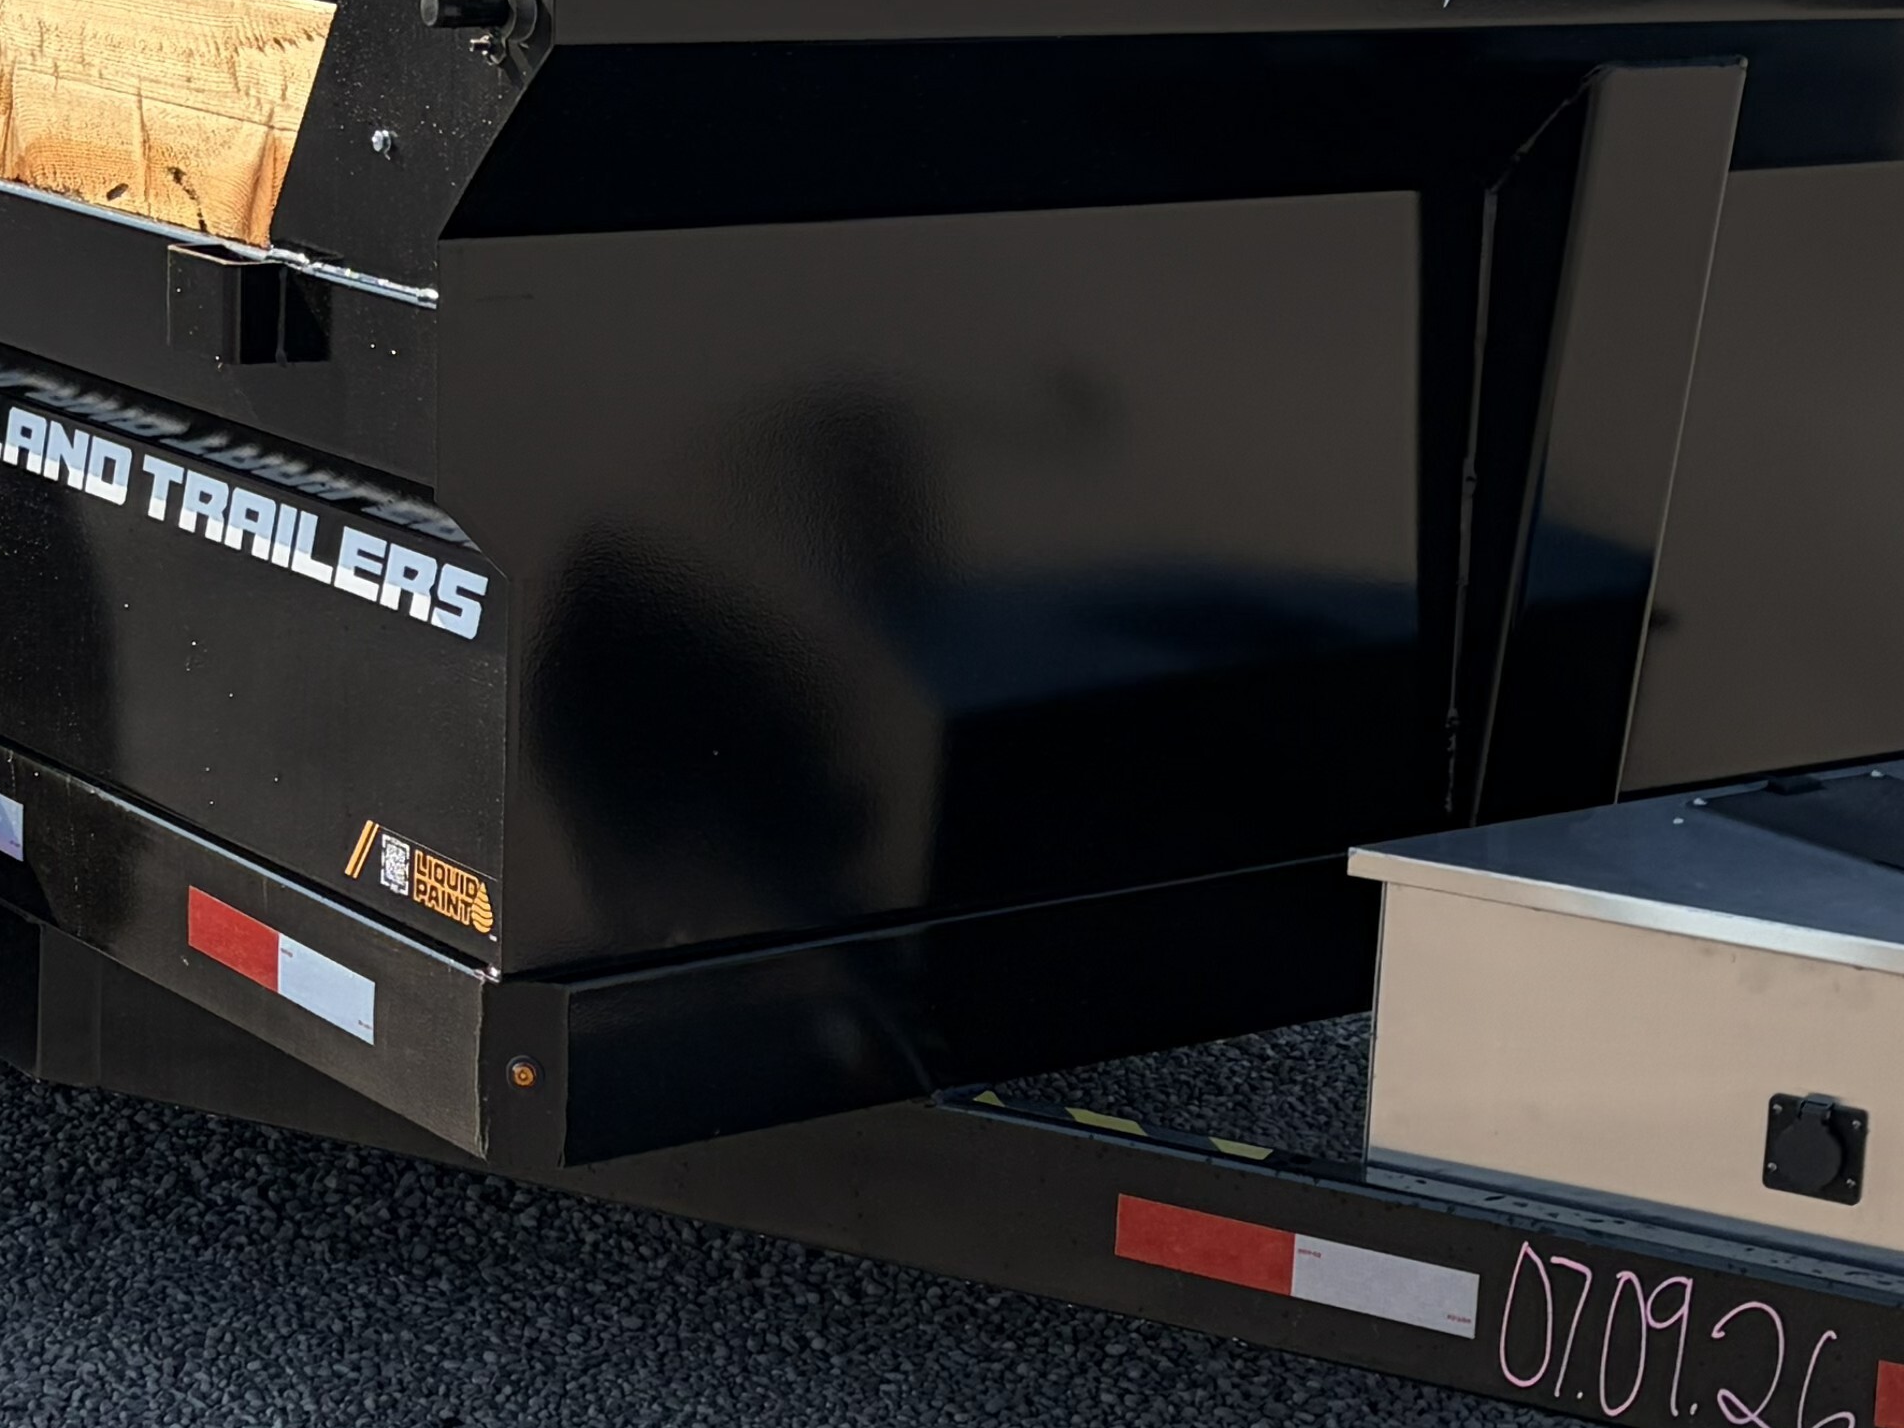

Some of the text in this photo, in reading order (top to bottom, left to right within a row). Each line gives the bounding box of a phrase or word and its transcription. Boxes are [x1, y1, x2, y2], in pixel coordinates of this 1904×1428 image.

[142, 453, 489, 640] TRAILERS
[414, 849, 481, 901] LIQUID
[413, 878, 474, 926] PAINT
